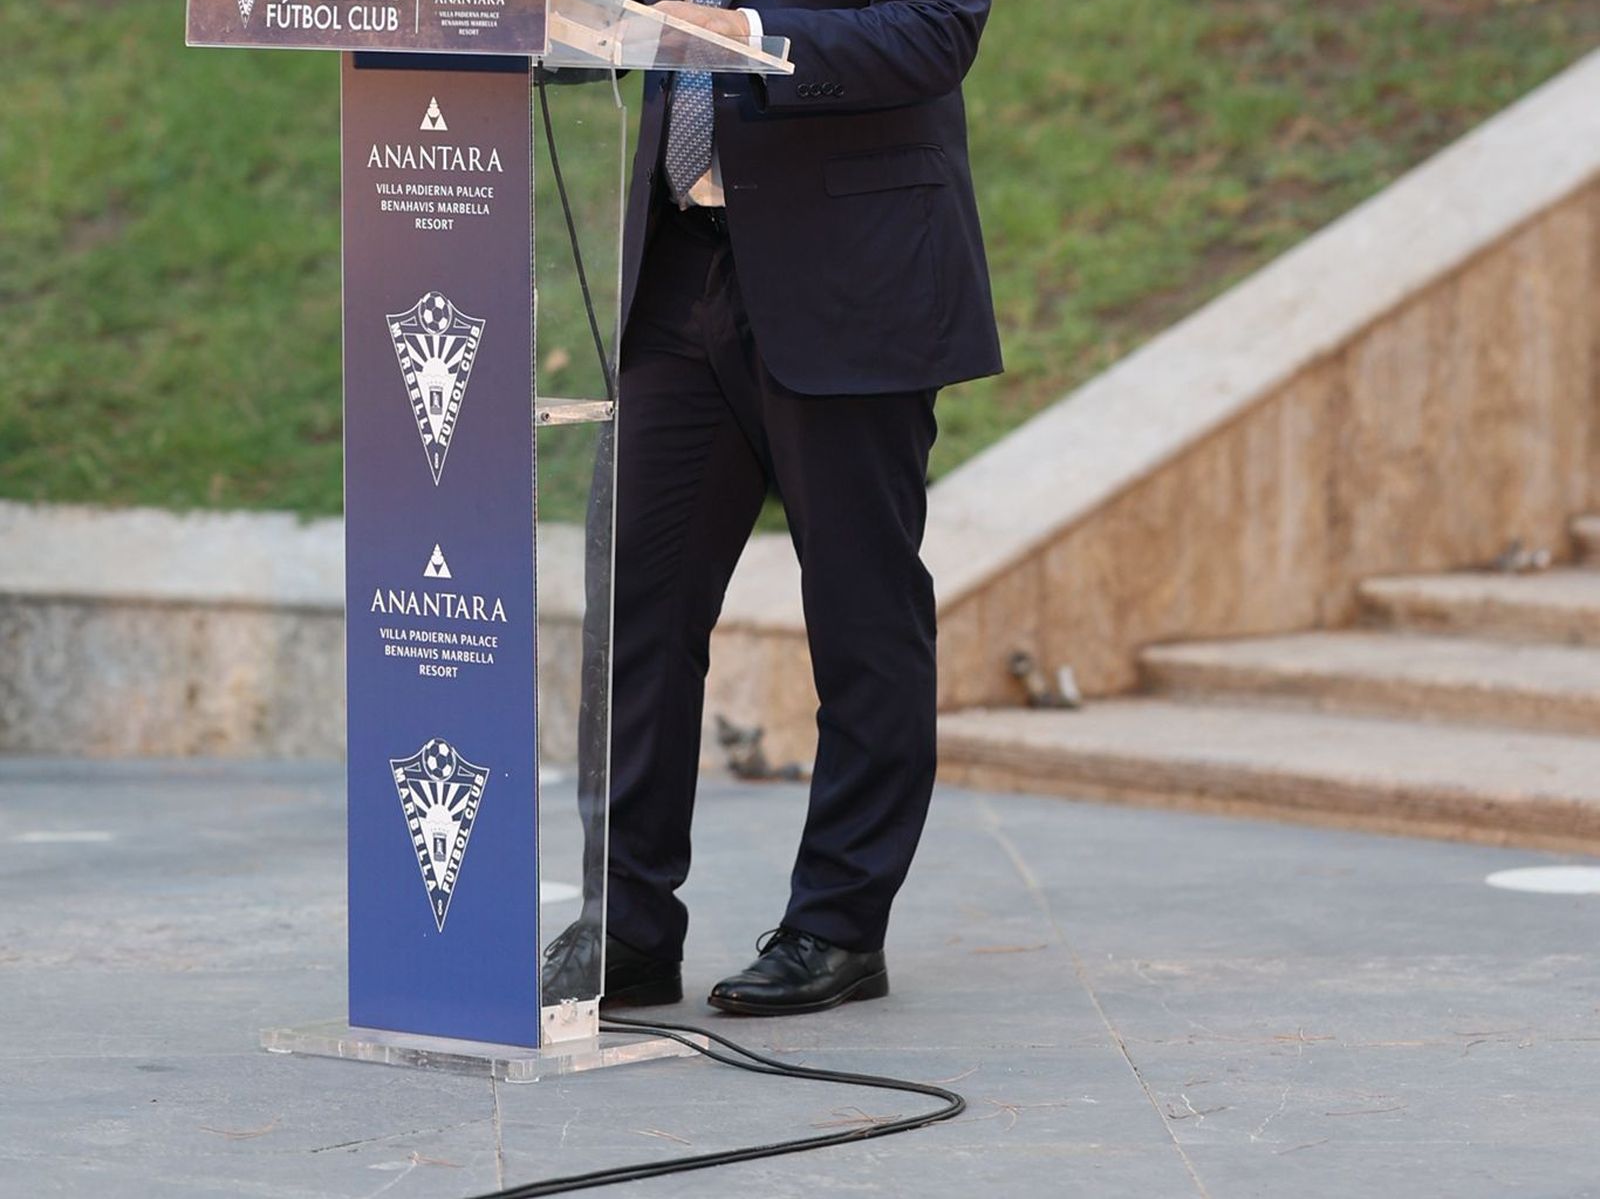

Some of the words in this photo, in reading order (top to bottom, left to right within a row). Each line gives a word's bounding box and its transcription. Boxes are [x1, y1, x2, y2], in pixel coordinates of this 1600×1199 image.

[348, 5, 399, 32] CLUB
[367, 144, 503, 173] ANANTARA
[376, 183, 403, 195] VILLA
[405, 184, 454, 197] PADIERNA
[456, 186, 494, 198] PALACE
[381, 200, 435, 213] BENAHAVIS
[437, 202, 490, 215] MARBELLA
[415, 218, 454, 230] RESORT
[390, 321, 434, 446] MARBELLA
[438, 379, 465, 447] FUTBOL
[460, 325, 480, 372] CLUB
[370, 588, 508, 622] ANANTARA
[379, 627, 407, 641] VILLA
[409, 630, 458, 644] PADIERNA
[460, 634, 498, 648] PALACE
[384, 645, 439, 660] BENAHAVIS
[441, 649, 494, 664] MARBELLA
[419, 664, 458, 678] RESORT
[394, 767, 437, 893] MARBELLA
[441, 827, 469, 894] FUTBOL
[464, 773, 485, 820] CLUB
